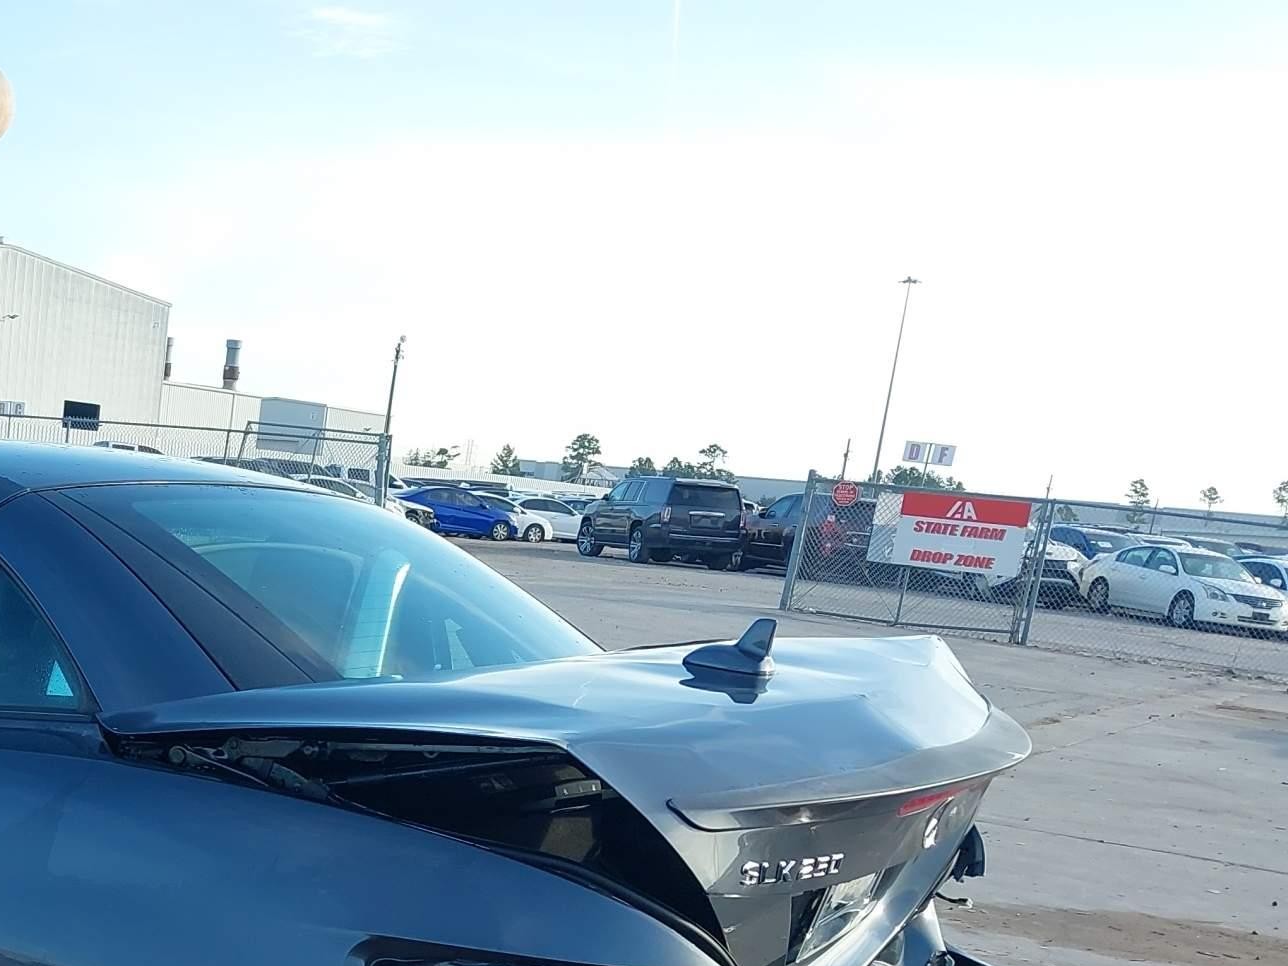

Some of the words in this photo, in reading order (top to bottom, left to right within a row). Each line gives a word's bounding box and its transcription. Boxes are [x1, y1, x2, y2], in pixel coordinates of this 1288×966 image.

[938, 446, 948, 463] F
[913, 520, 959, 536] STATE
[960, 526, 1006, 541] FARM
[910, 549, 954, 564] DROP
[953, 554, 996, 570] ZONE
[740, 860, 796, 885] SLK
